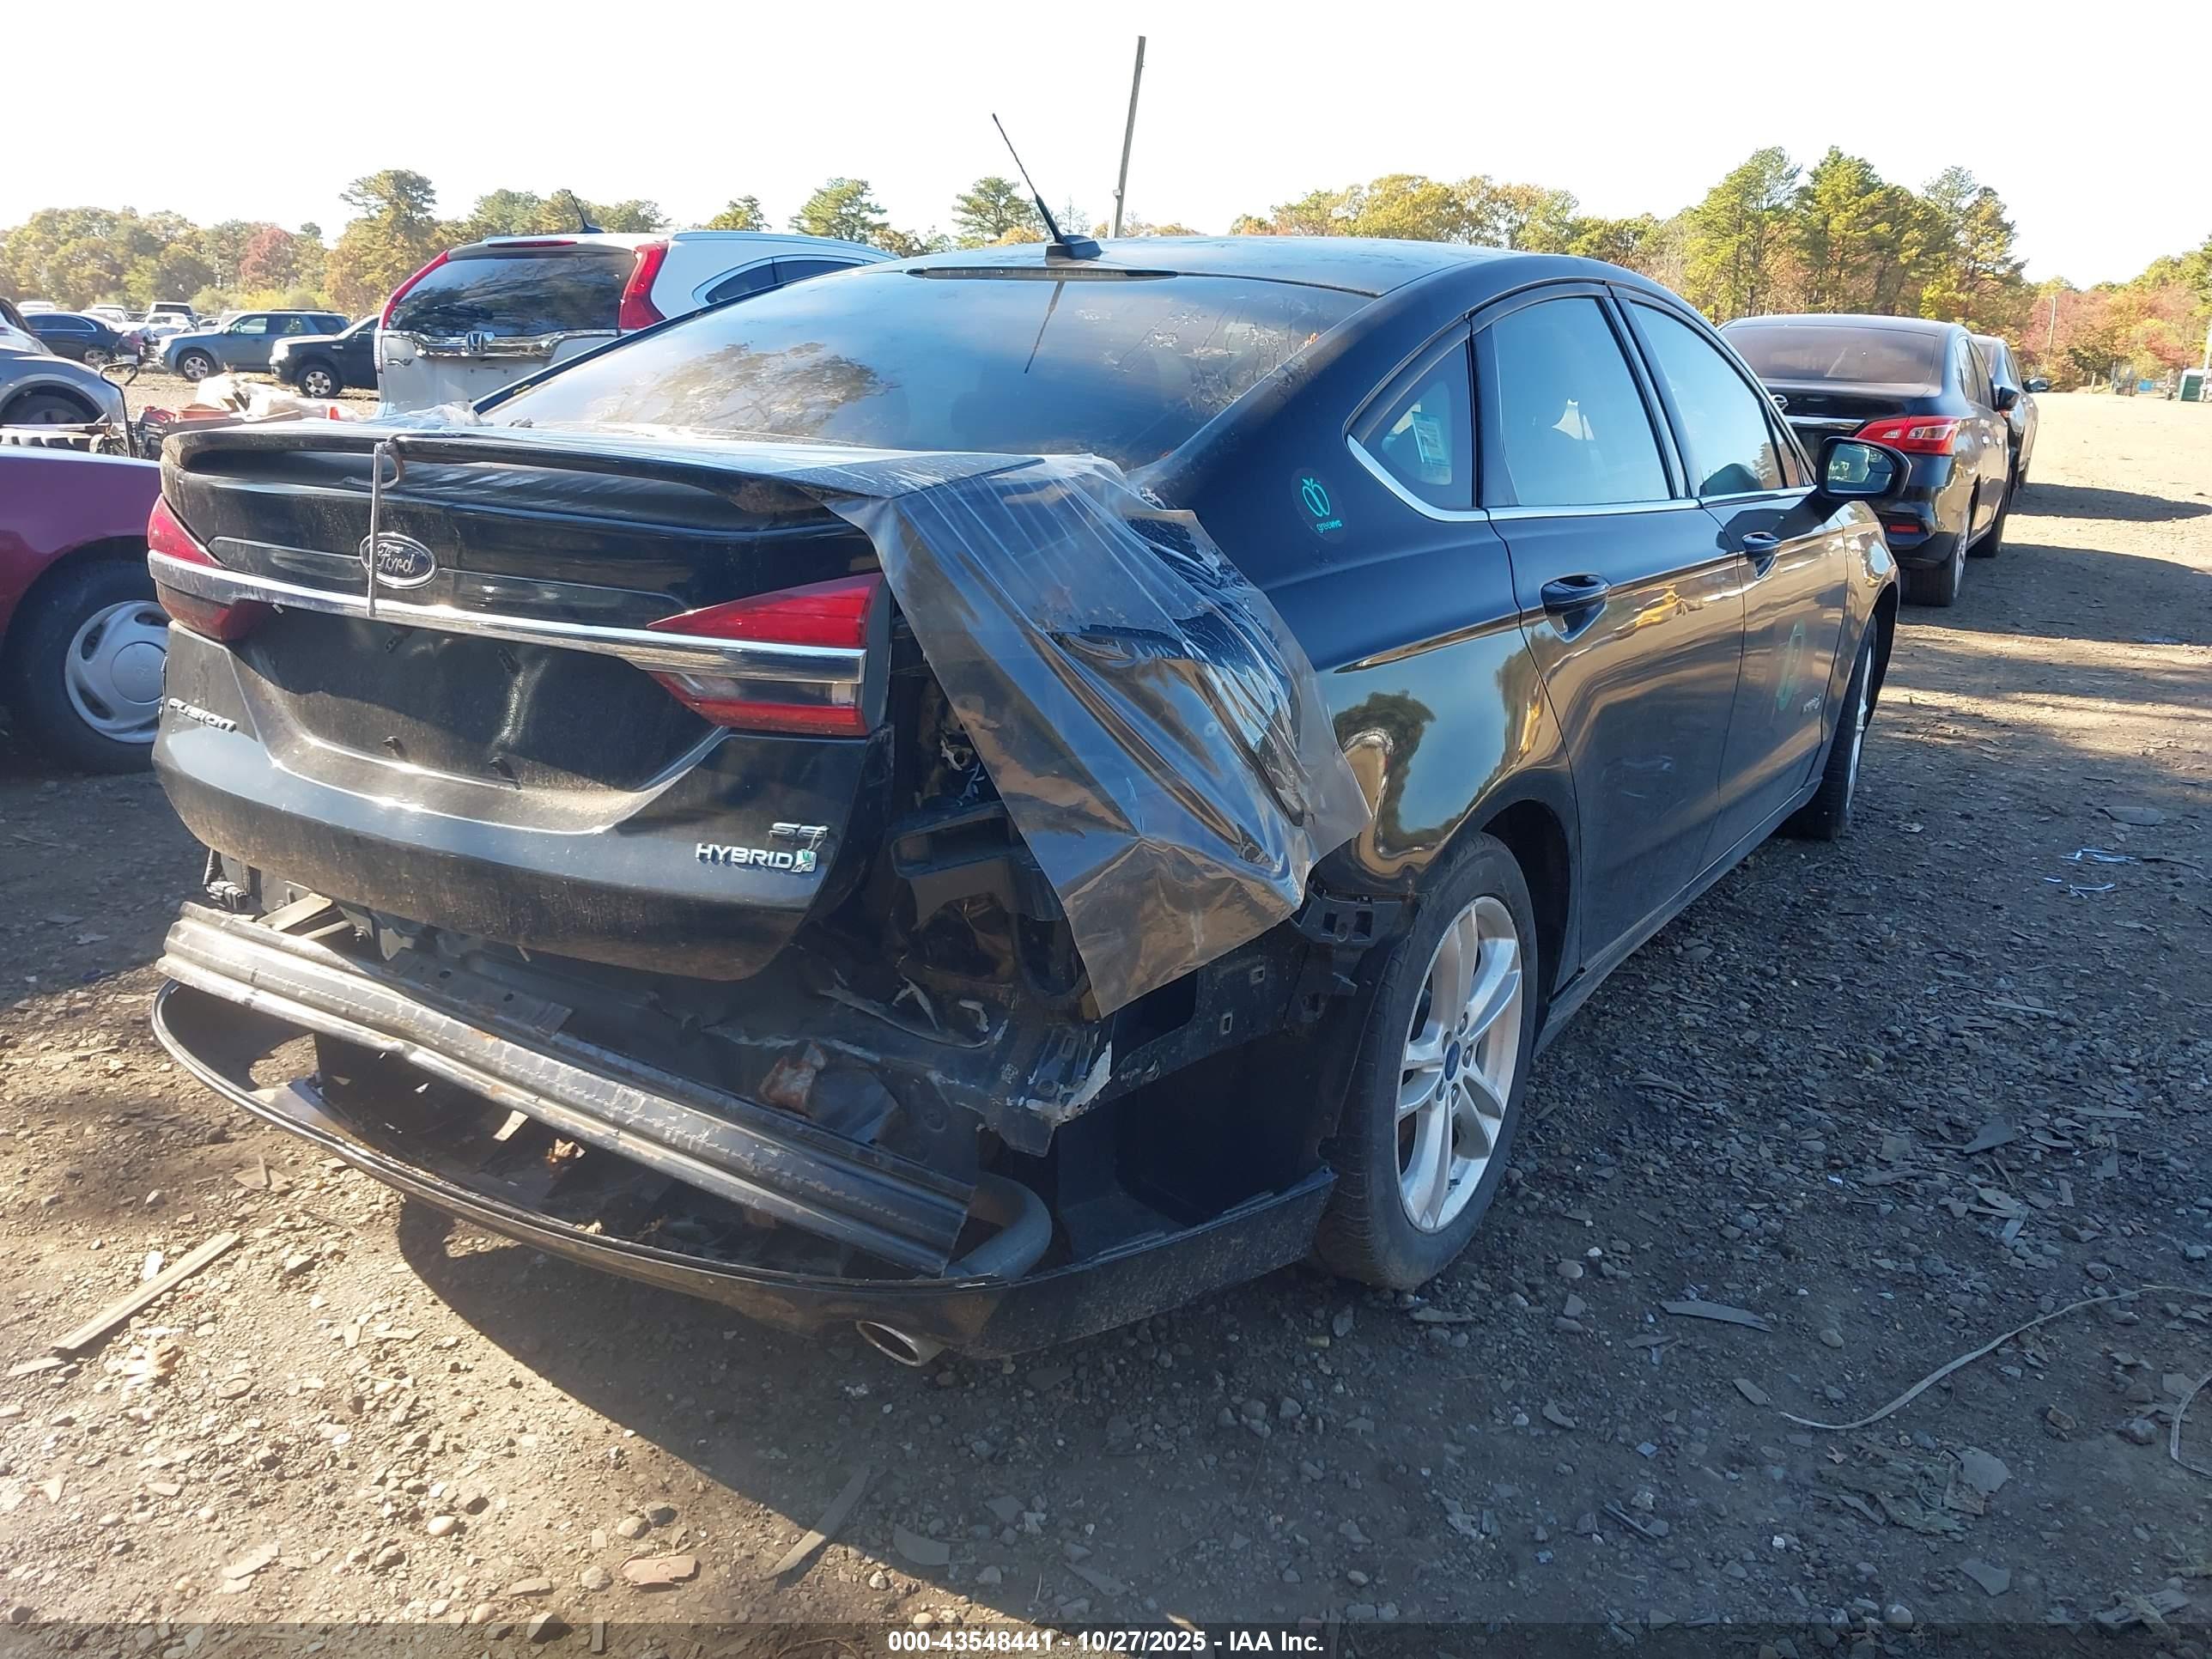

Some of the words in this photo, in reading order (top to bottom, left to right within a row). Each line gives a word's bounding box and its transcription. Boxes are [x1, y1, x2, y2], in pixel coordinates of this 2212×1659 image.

[375, 541, 416, 574] Ford
[769, 822, 830, 839] SE
[695, 842, 794, 870] HYBRID
